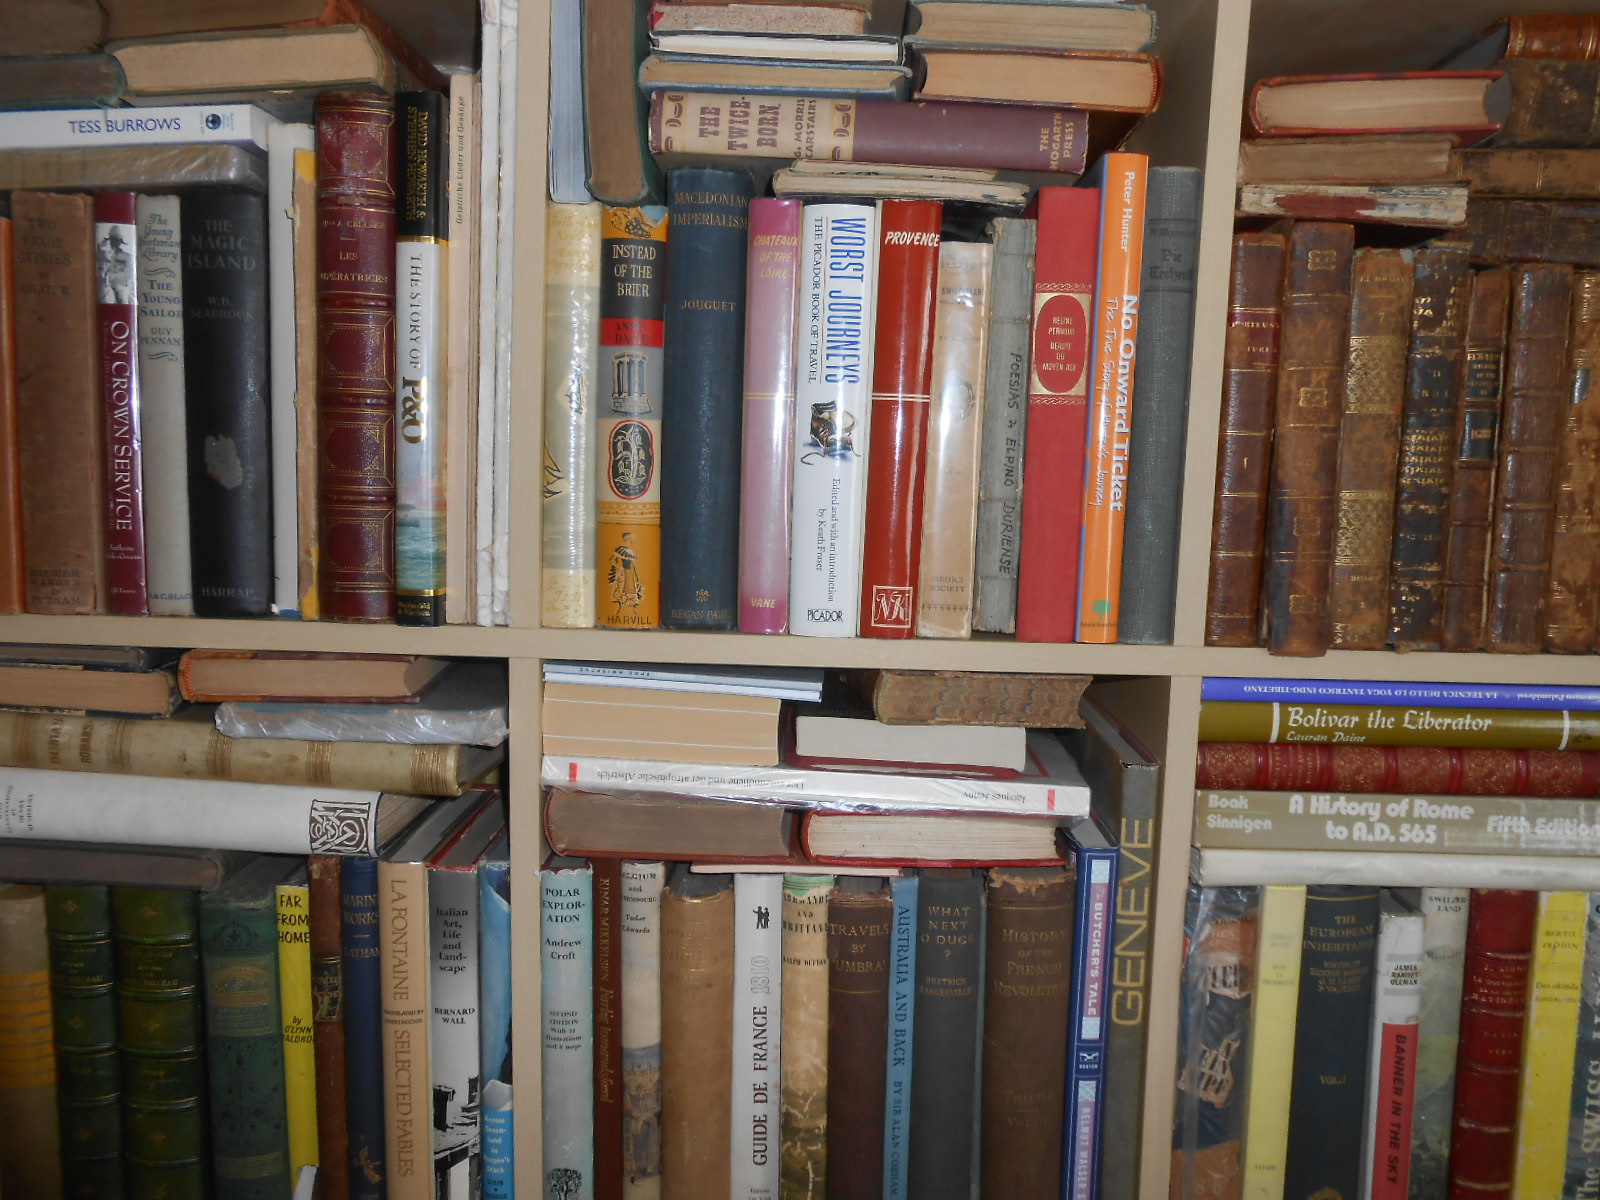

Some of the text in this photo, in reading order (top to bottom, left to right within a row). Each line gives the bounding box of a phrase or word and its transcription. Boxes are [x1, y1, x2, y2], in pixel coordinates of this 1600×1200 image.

[69, 117, 181, 133] TESS BURROWS
[699, 106, 721, 138] THE
[795, 98, 806, 143] MORRIS
[418, 111, 428, 146] DAVID
[804, 99, 817, 159] CARSTAIRS
[1039, 127, 1049, 151] THE
[1049, 112, 1063, 170] HOGARTH
[1063, 121, 1075, 158] PRESS
[674, 191, 748, 208] MACEDONIAN
[1121, 171, 1136, 252] Peter Hunter
[148, 213, 168, 226] The
[203, 219, 233, 232] THE
[143, 227, 174, 241] Young
[753, 234, 799, 247] CHATEAUX
[884, 230, 941, 247] PROVENCE
[191, 235, 249, 250] MAGIC
[142, 249, 178, 263] Library
[612, 245, 656, 260] INSTEAD
[760, 252, 792, 263] OF THE
[187, 254, 257, 271] ISLAND
[614, 264, 653, 279] OF THE
[760, 268, 789, 279] LOIRE
[149, 279, 173, 291] THE
[617, 282, 650, 297] BRIER
[141, 293, 181, 305] YOUNG
[681, 299, 737, 312] JOUGUET
[808, 217, 824, 384] THE PICADOR BOOK OF TRAVEL
[825, 217, 867, 384] WORST JOURNEYS
[409, 254, 423, 369] THE STORY OF
[151, 328, 172, 336] GUY
[1006, 351, 1023, 410] POESIAS
[1087, 297, 1119, 507] The True Story Journey
[1109, 295, 1138, 512] No Onward Ticket
[401, 375, 428, 445] P&O
[111, 321, 133, 531] ON CROWN SERVICE
[1003, 437, 1017, 488] ELPINO
[831, 478, 841, 506] Edited
[831, 506, 839, 522] and
[816, 508, 827, 571] by Keath Fraser
[998, 501, 1016, 576] DURIENSE
[828, 553, 837, 602] introduction
[201, 587, 255, 599] HARRAP
[751, 598, 777, 609] VANE
[607, 615, 653, 626] HARVILL
[807, 609, 844, 622] PICADOR
[1243, 684, 1498, 700] LA TECNICA DELLO YOGA TANTRICO INDO-TIBETANO
[1287, 706, 1493, 732] Bolivar the Liberator
[1286, 731, 1328, 742] Lauran
[597, 769, 690, 784] atrophische Abstrich
[1208, 794, 1249, 809] Boak
[1288, 794, 1475, 823] A History of Rome
[1206, 813, 1273, 834] Sinnigen
[1487, 815, 1600, 837] Fifth Edition
[1325, 820, 1438, 845] to A.D. 565
[545, 887, 580, 897] POLAR
[628, 885, 643, 893] and
[280, 895, 302, 908] FAR
[542, 900, 586, 911] EXPLOR-
[1437, 905, 1463, 913] LAND
[436, 907, 469, 917] Italian
[546, 914, 580, 923] ATION
[928, 905, 972, 918] WHAT
[277, 912, 310, 927] FROM
[442, 918, 463, 929] Art,
[928, 919, 969, 932] NEXT
[1111, 816, 1154, 1026] GENEVE
[1334, 915, 1358, 925] THE
[279, 931, 311, 944] HOME
[443, 929, 462, 939] Life
[829, 923, 889, 937] TRAVELS
[1002, 928, 1067, 943] HISTORY
[1309, 925, 1376, 937] EUROPEAN
[391, 879, 409, 1001] LA FONTAINE
[442, 941, 461, 950] and
[545, 937, 581, 947] Andrew
[920, 934, 975, 946] O DUCE
[1089, 902, 1104, 977] BUTCHER'S
[550, 951, 575, 960] Croft
[851, 943, 867, 953] BY
[1017, 949, 1031, 958] OF
[439, 952, 468, 962] Land-
[439, 964, 467, 975] scape
[1007, 961, 1063, 977] FRENCH
[893, 906, 911, 1066] AUSTRALIA AND BACK
[1087, 982, 1099, 1016] TALE
[434, 1007, 476, 1016] BERNARD
[293, 1015, 302, 1024] by
[442, 1017, 467, 1025] WALL
[751, 1005, 768, 1072] FRANCE
[752, 1081, 768, 1104] DE
[394, 1029, 414, 1178] SELECTED FABLES
[1385, 1033, 1408, 1185] BANNER IN THE SKY
[751, 1113, 768, 1167] GUIDE
[889, 1081, 903, 1197] BY SIR ALAN COBHAM
[1077, 1107, 1091, 1189] HELMUT WALSER
